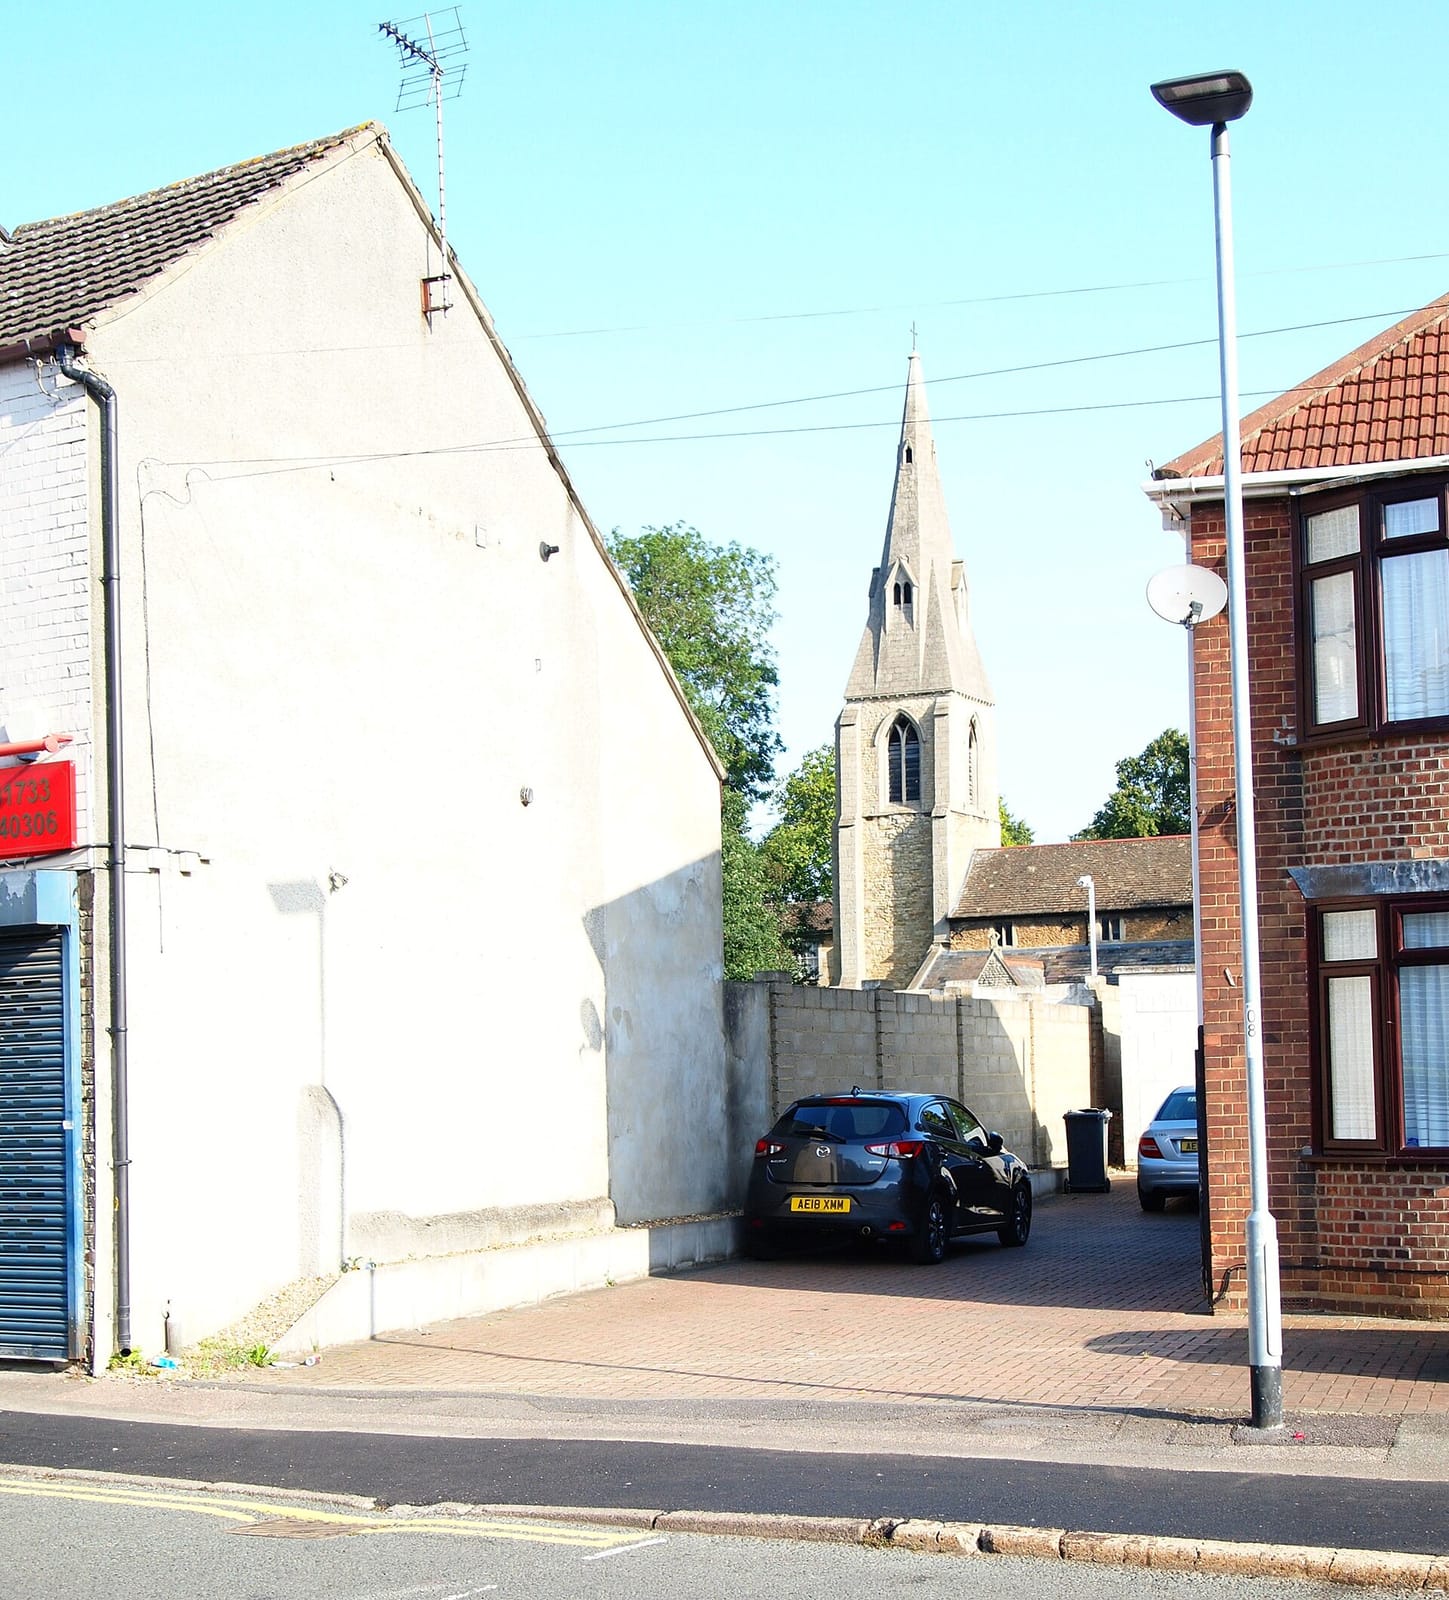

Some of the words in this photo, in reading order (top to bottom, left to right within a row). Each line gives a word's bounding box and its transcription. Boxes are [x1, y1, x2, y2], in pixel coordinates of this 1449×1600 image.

[0, 777, 51, 807] 1733
[797, 1199, 820, 1209] AE18
[823, 1199, 844, 1210] XMM
